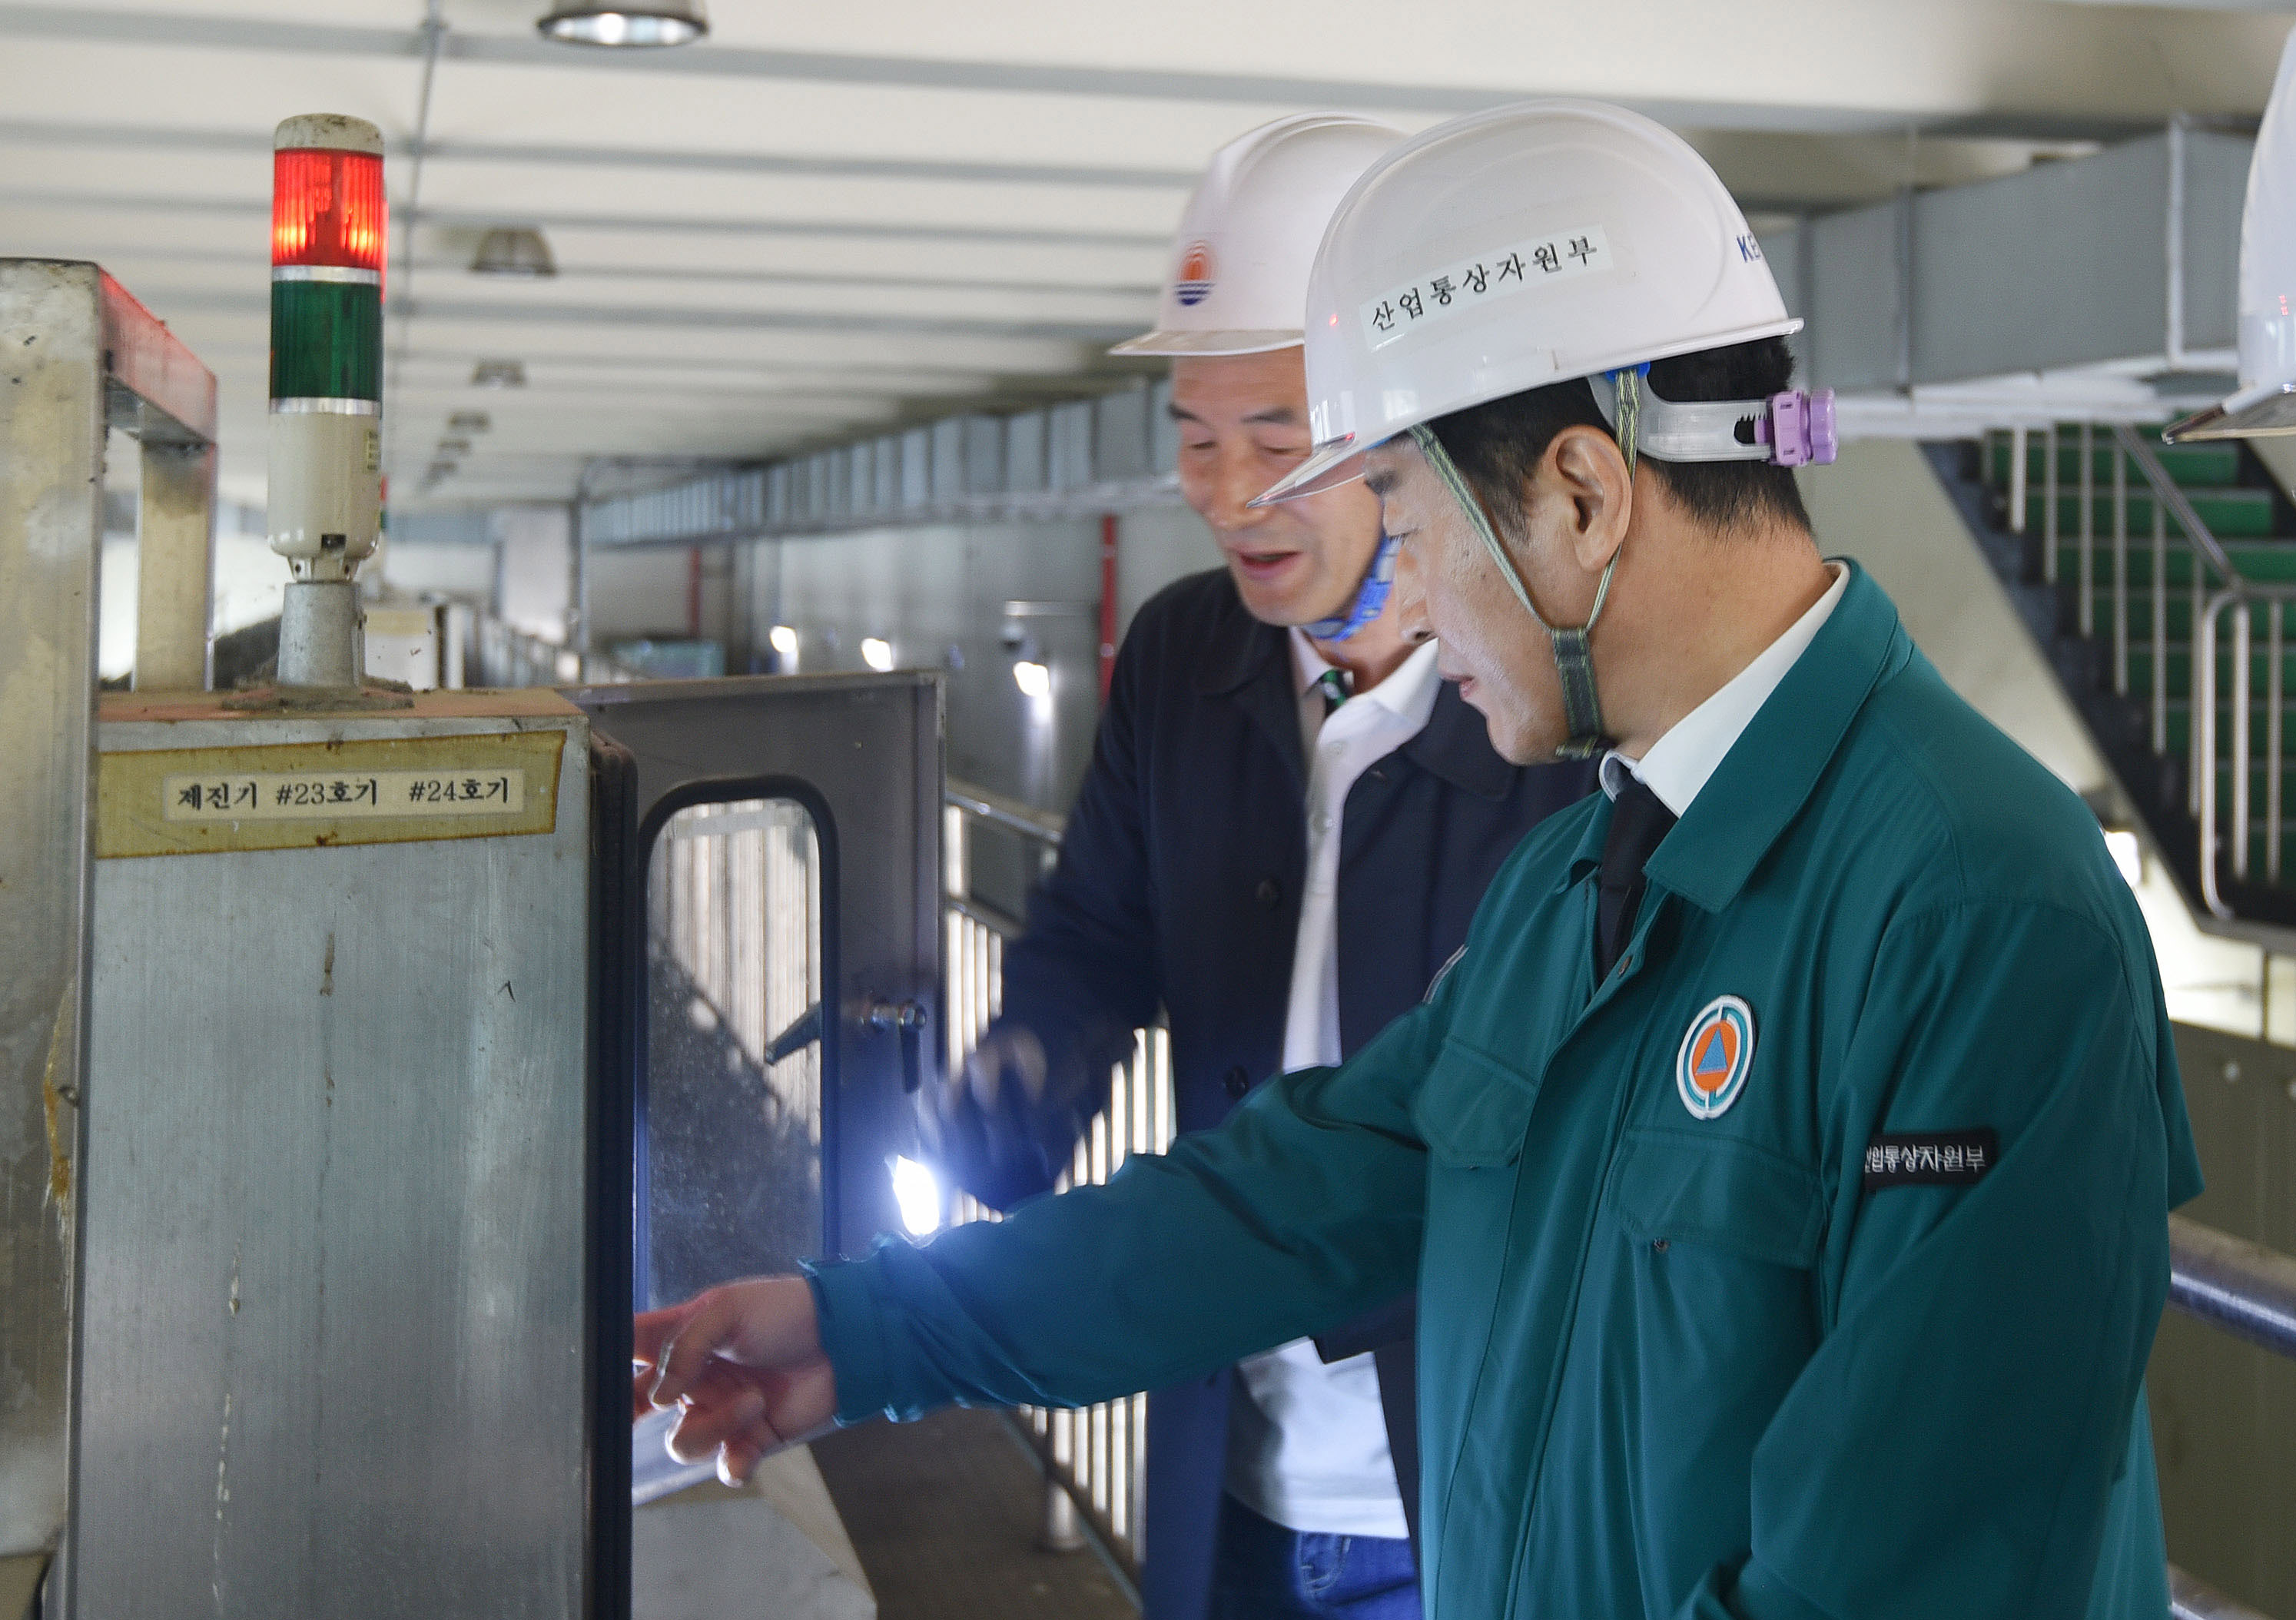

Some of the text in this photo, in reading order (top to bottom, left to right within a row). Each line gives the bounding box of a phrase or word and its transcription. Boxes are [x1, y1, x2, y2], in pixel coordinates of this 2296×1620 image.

[1372, 235, 1598, 332] 산업통상자원부
[178, 776, 510, 811] 제진기 #23호기 #24호기
